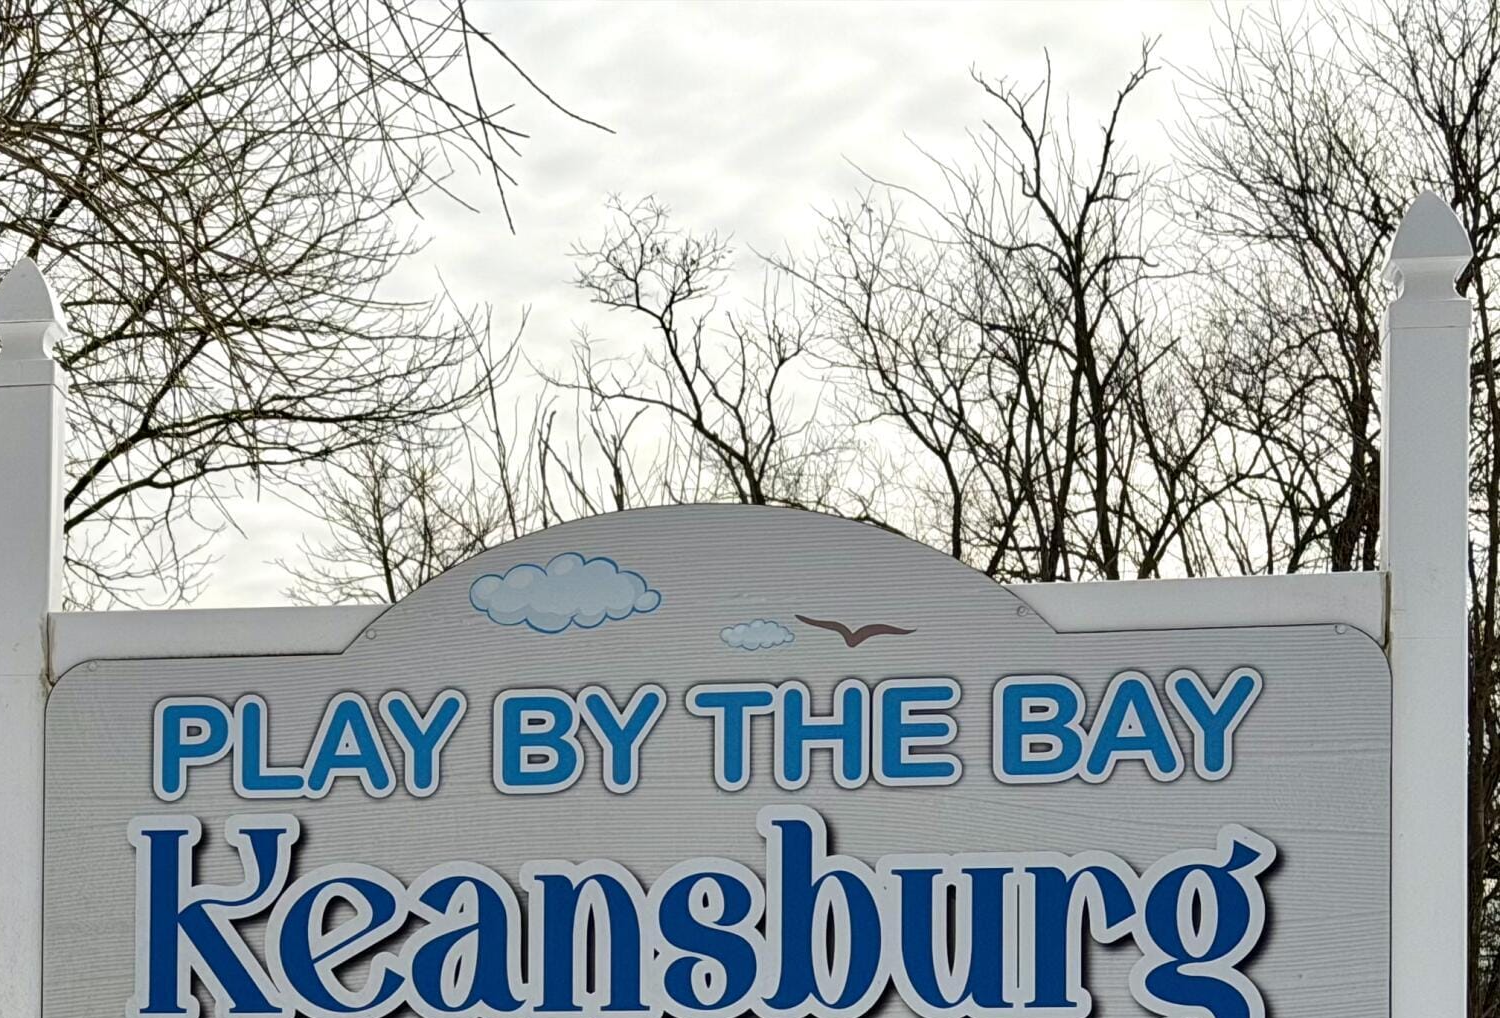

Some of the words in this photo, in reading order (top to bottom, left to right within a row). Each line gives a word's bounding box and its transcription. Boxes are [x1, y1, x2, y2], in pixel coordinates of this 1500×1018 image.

[155, 690, 465, 798] PLAY
[496, 685, 666, 793] BY
[688, 678, 960, 789] THE
[994, 669, 1260, 783] BAY
